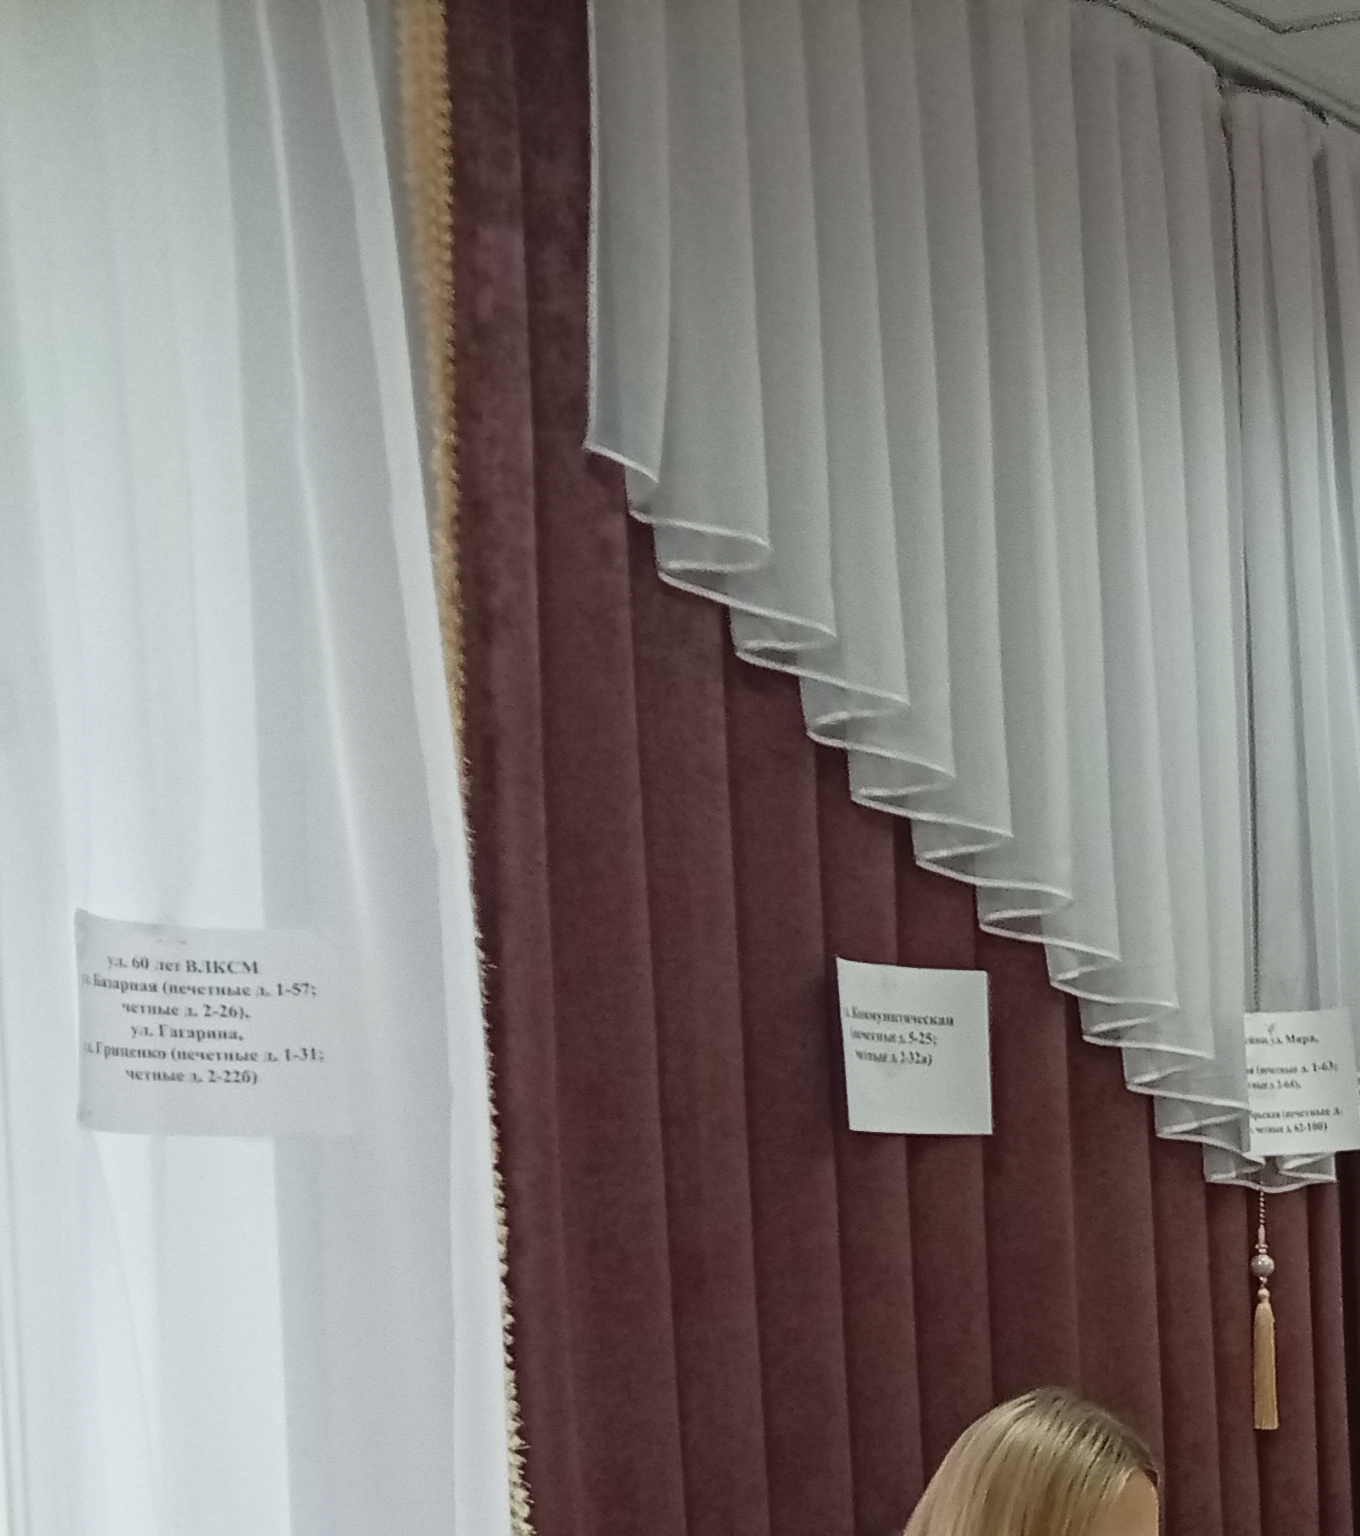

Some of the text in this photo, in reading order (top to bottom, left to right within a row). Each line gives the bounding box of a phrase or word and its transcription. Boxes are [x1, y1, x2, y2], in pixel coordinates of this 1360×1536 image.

[131, 955, 150, 970] 60
[154, 960, 181, 973] лет
[186, 959, 260, 975] ВЛКСМ
[162, 981, 251, 998] (нечетные
[121, 1003, 179, 1017] четные
[158, 1023, 244, 1043] Гагарина,
[170, 1047, 258, 1063] (нечетные
[125, 1069, 185, 1082] четные
